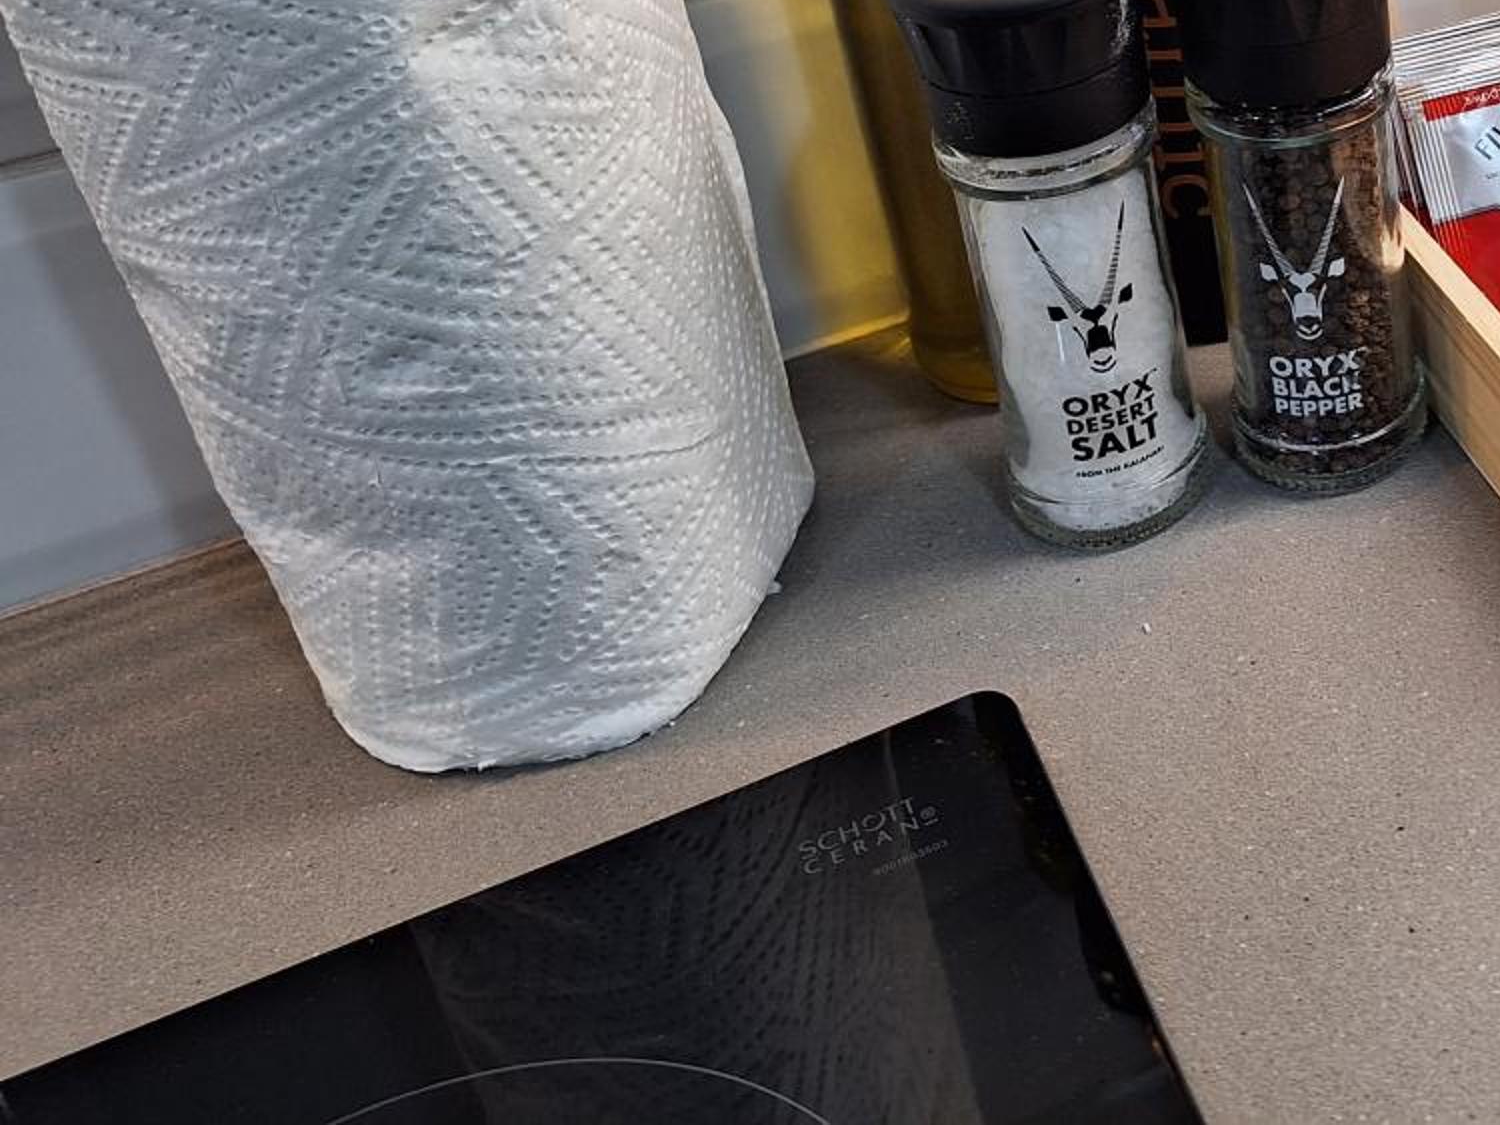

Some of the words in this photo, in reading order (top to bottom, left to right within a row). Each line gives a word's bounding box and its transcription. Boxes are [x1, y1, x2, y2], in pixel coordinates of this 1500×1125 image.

[1269, 353, 1360, 377] ORYX
[1062, 373, 1154, 417] ORYX
[1273, 374, 1362, 398] BLACK
[1067, 394, 1156, 436] DESERT
[1275, 393, 1364, 418] PEPPER
[1071, 412, 1159, 463] SALT
[1076, 467, 1102, 480] FROM
[1106, 466, 1121, 474] THE
[799, 797, 914, 856] SCHOTT
